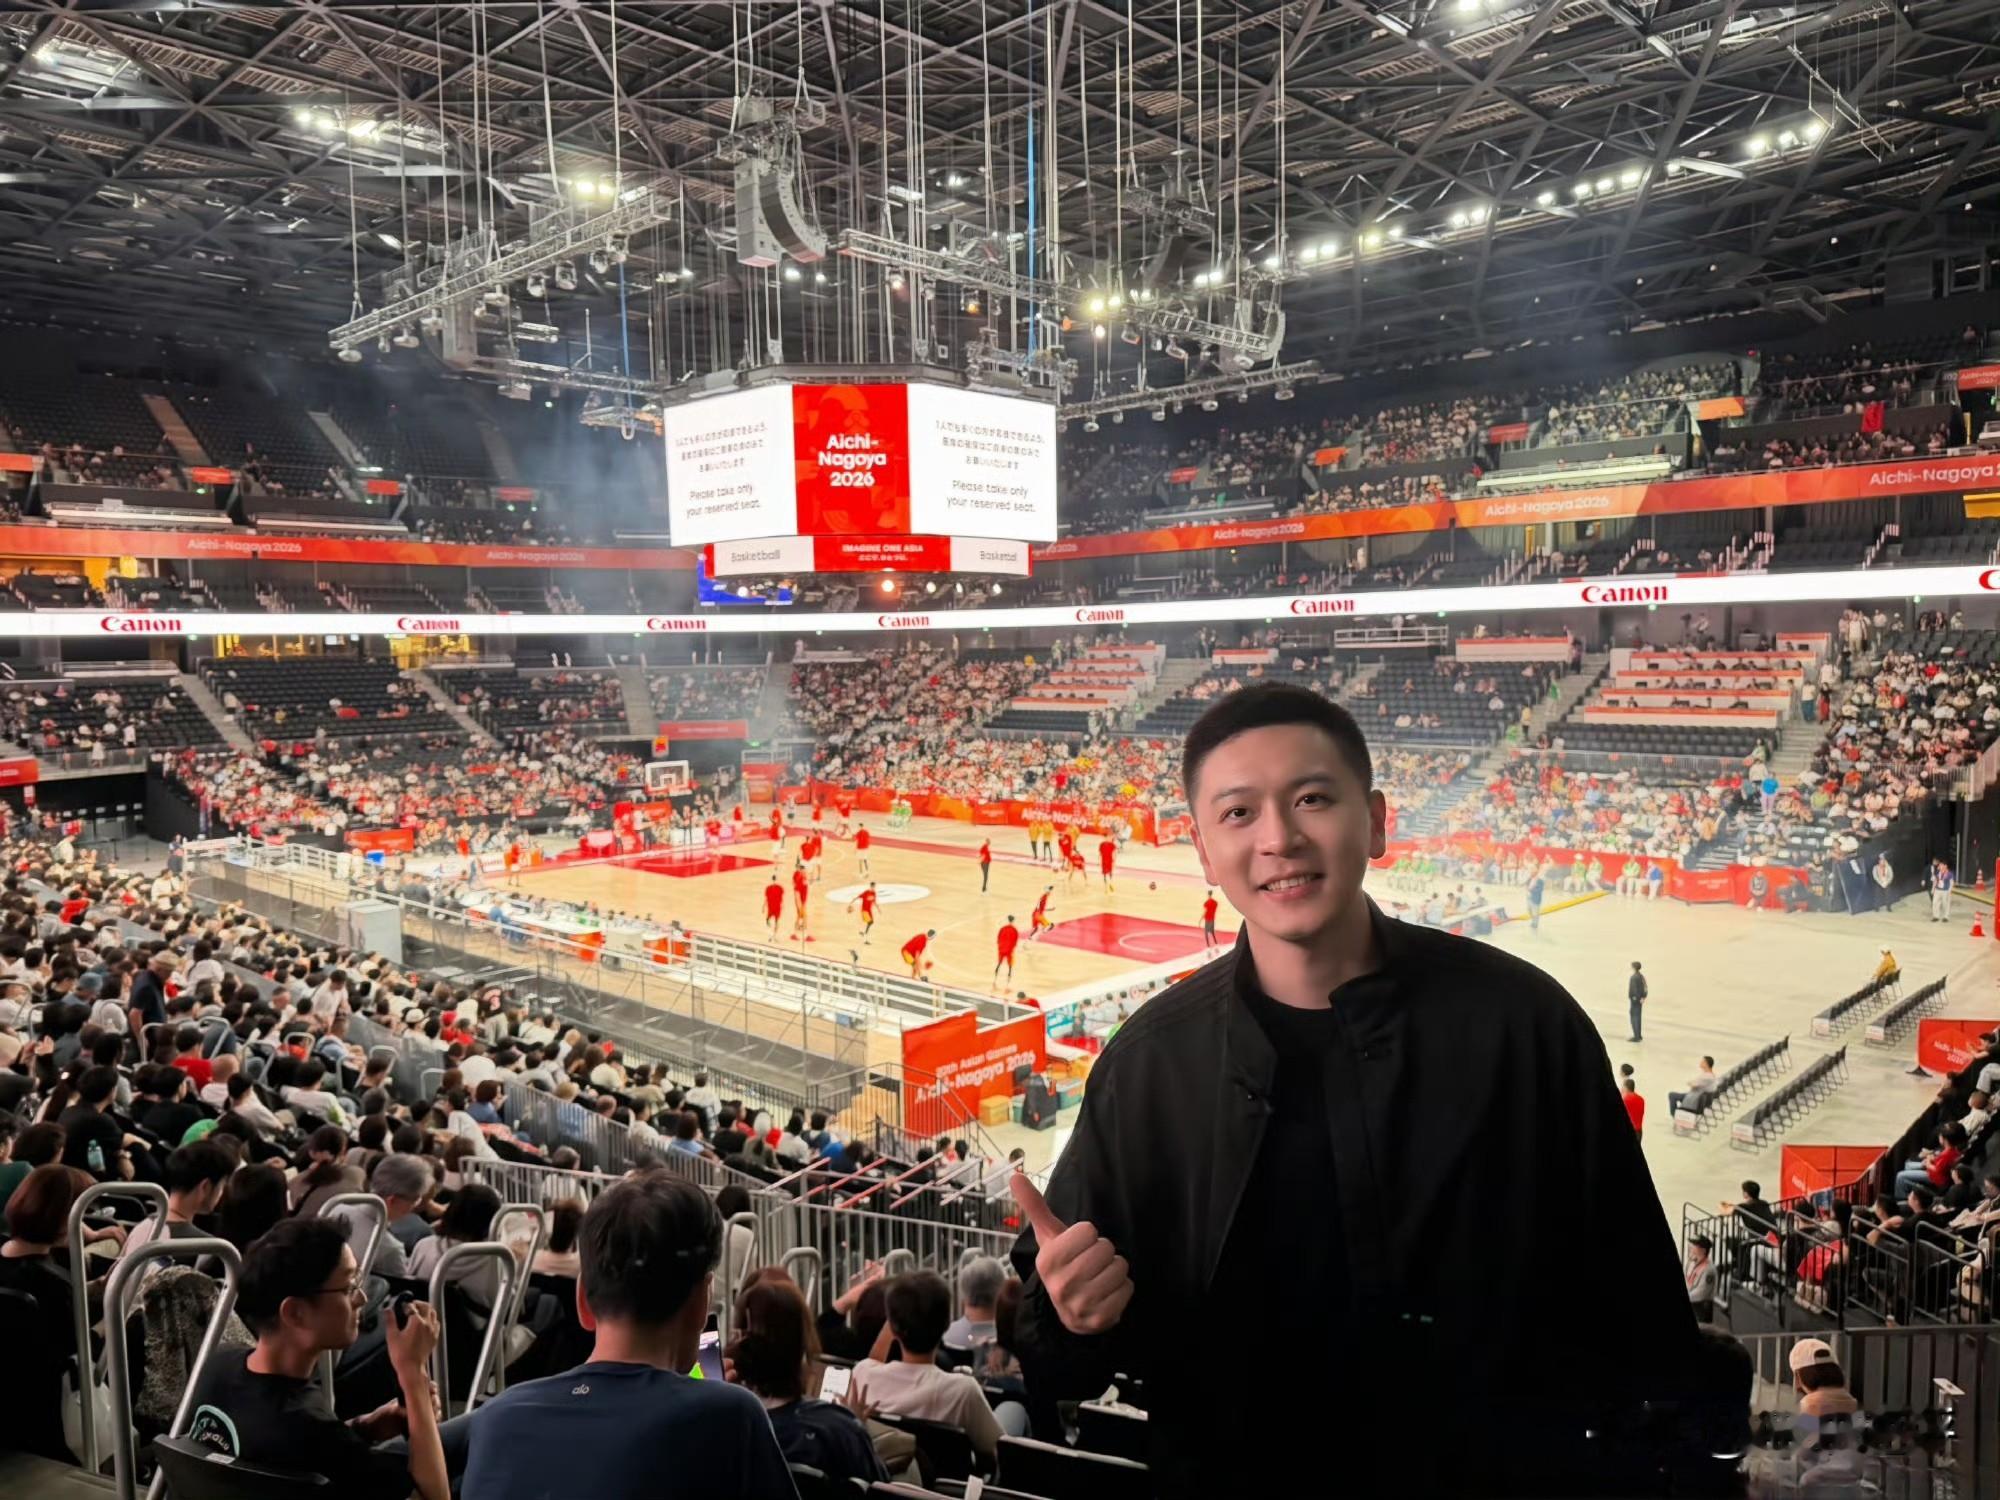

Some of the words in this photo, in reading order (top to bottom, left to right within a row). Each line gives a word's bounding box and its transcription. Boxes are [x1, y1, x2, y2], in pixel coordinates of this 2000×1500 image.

[826, 432, 880, 450] Aichi-
[817, 450, 888, 470] Nagoya
[829, 471, 876, 487] 2026
[952, 480, 983, 493] Please
[986, 484, 1008, 495] take
[1010, 485, 1029, 499] only
[947, 497, 968, 509] your
[970, 499, 1011, 511] reserved
[731, 549, 781, 562] Basketball
[882, 543, 902, 553] ONE
[903, 543, 924, 553] ASIA
[1582, 584, 1668, 603] Canon
[1290, 599, 1354, 615] Canon
[878, 615, 930, 627] Canon
[1076, 608, 1124, 622] Canon
[100, 615, 182, 632] Canon
[397, 617, 460, 631] Canon
[647, 617, 706, 630] Canon
[960, 1053, 985, 1070] Asian
[571, 1384, 590, 1395] alo
